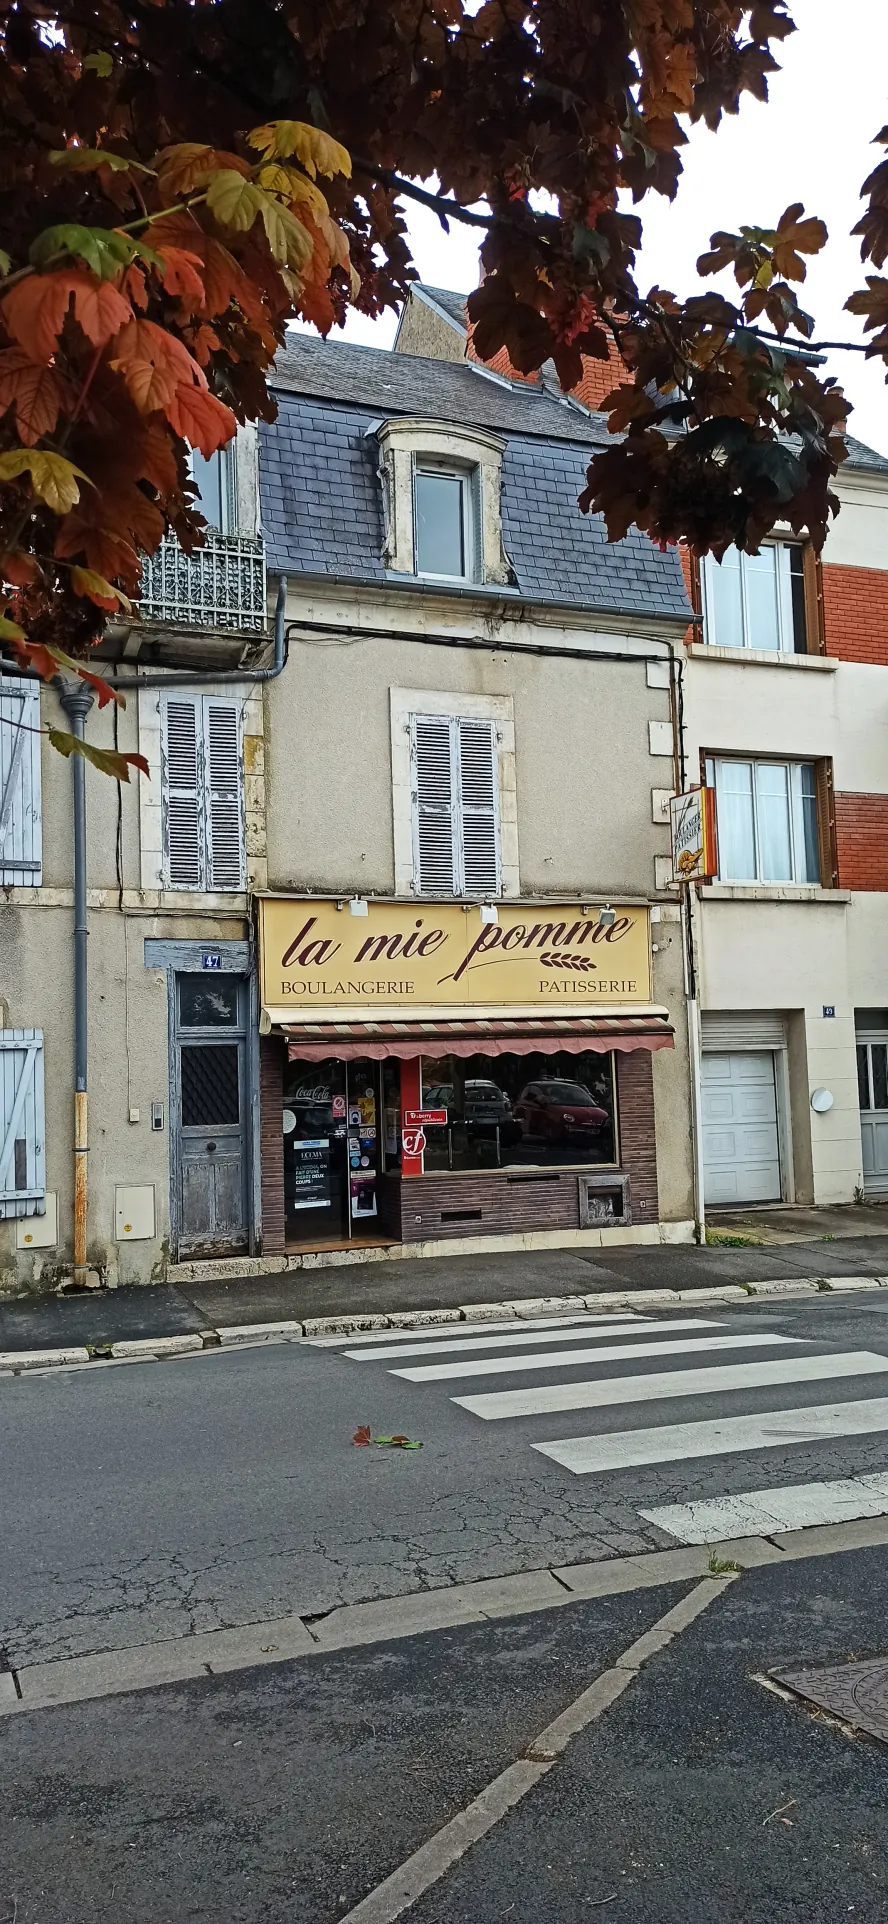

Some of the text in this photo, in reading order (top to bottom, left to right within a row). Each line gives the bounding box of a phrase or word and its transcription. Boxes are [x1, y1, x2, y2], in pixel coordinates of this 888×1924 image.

[281, 916, 637, 982] la mie pomme
[206, 955, 219, 967] 47
[281, 981, 415, 995] BOULANGERIE
[539, 980, 637, 993] PATISSERIE
[825, 1007, 833, 1015] 49
